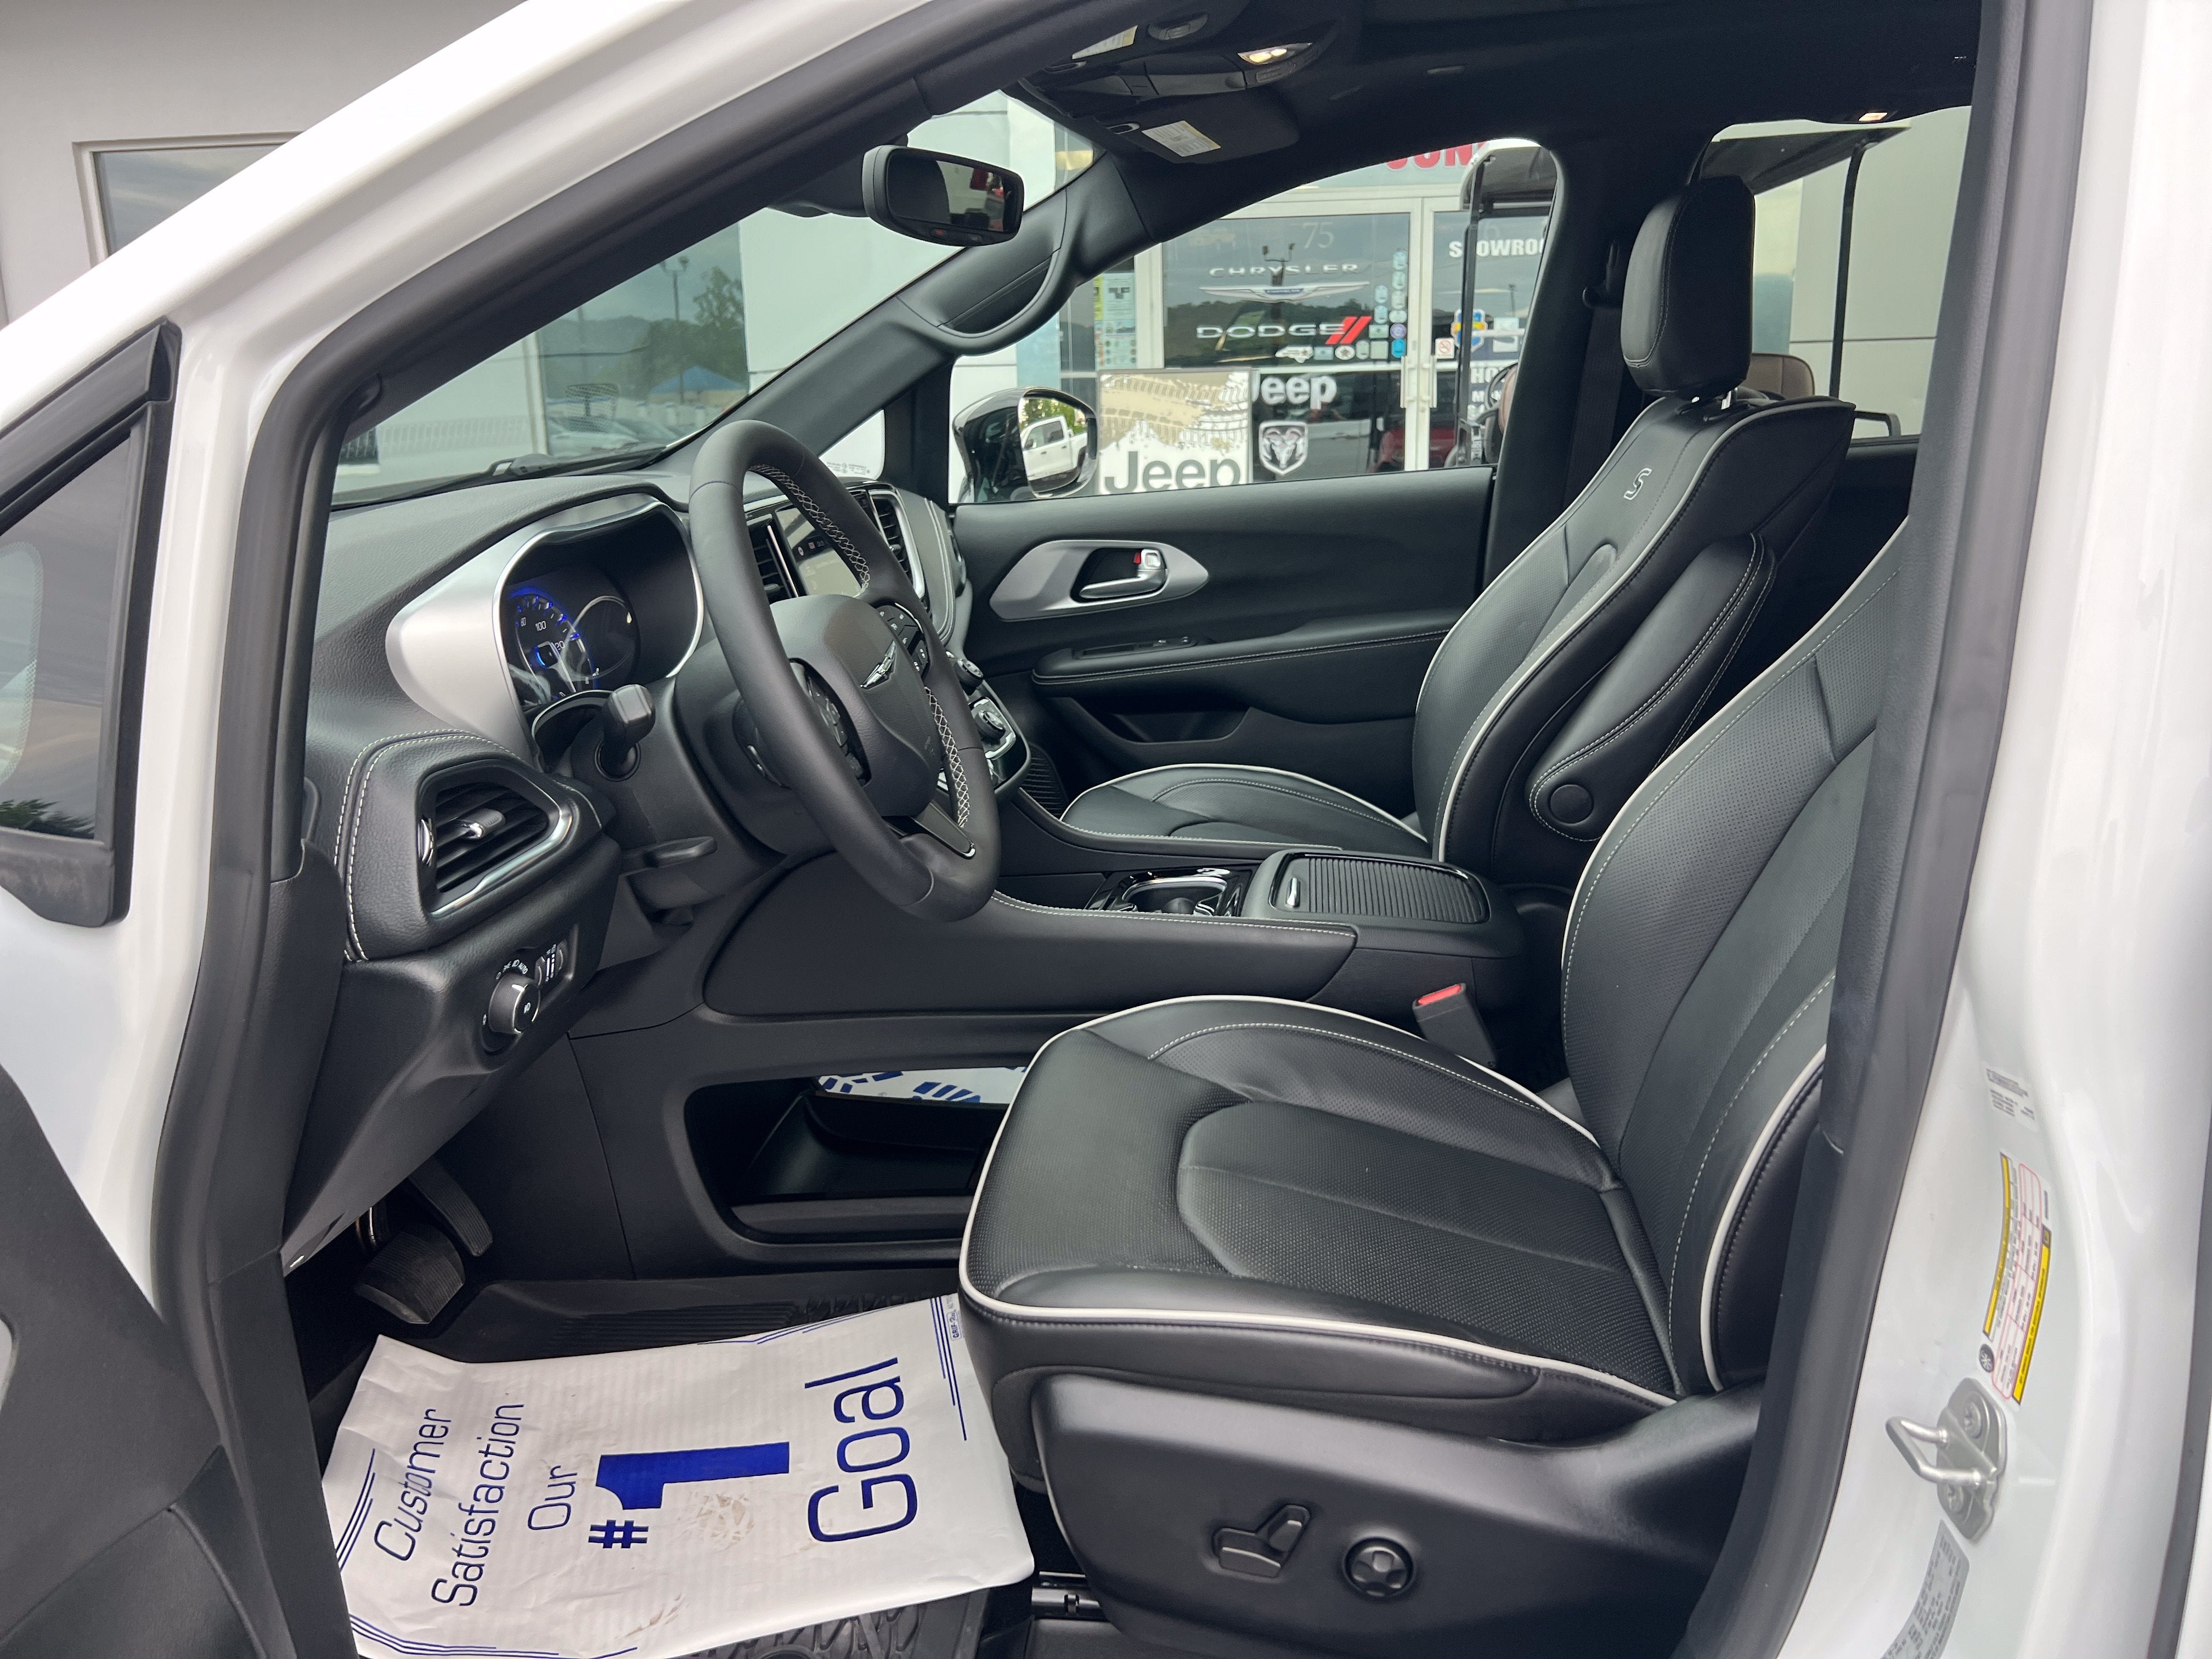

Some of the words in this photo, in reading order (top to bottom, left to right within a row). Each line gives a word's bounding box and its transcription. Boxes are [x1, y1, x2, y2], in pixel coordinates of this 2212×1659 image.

[1449, 238, 1544, 258] SOWRO
[1209, 263, 1359, 277] CHRYSLER
[1196, 323, 1346, 338] DODGE
[1104, 450, 1241, 493] Jeep
[535, 621, 546, 631] 100
[805, 1357, 918, 1542] Goal
[375, 1408, 452, 1561] Customer
[432, 1403, 524, 1607] Satisfaction
[528, 1465, 578, 1531] Our
